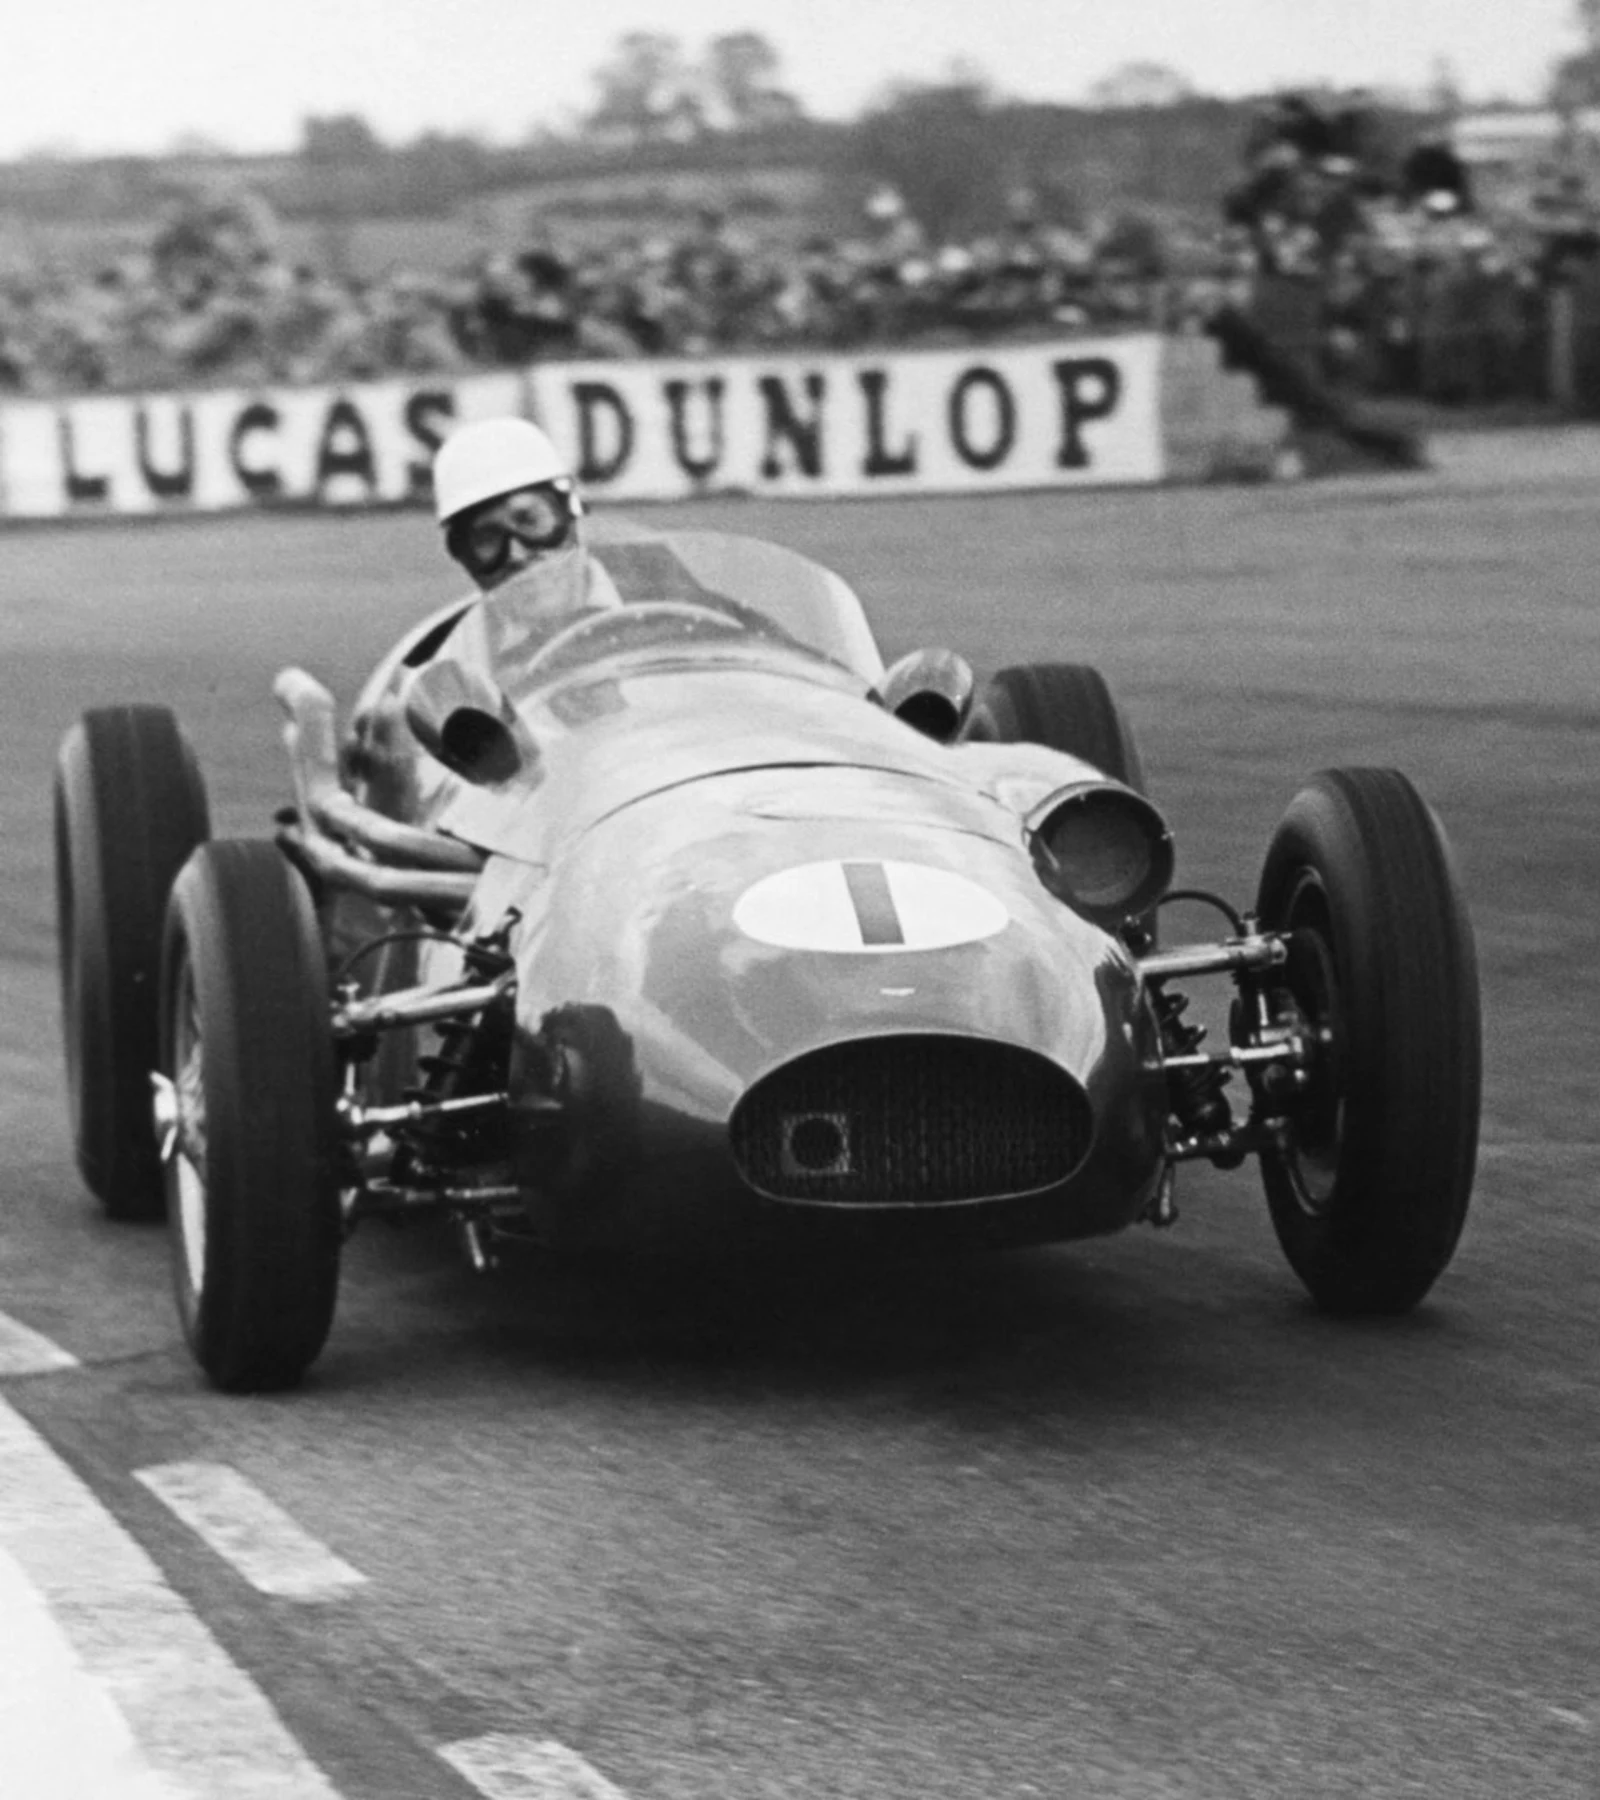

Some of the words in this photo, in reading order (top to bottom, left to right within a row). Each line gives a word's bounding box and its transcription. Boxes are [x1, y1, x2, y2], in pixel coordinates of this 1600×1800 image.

[58, 393, 456, 500] LUCAS
[570, 356, 1122, 483] DUNLOP
[840, 861, 906, 946] 1
